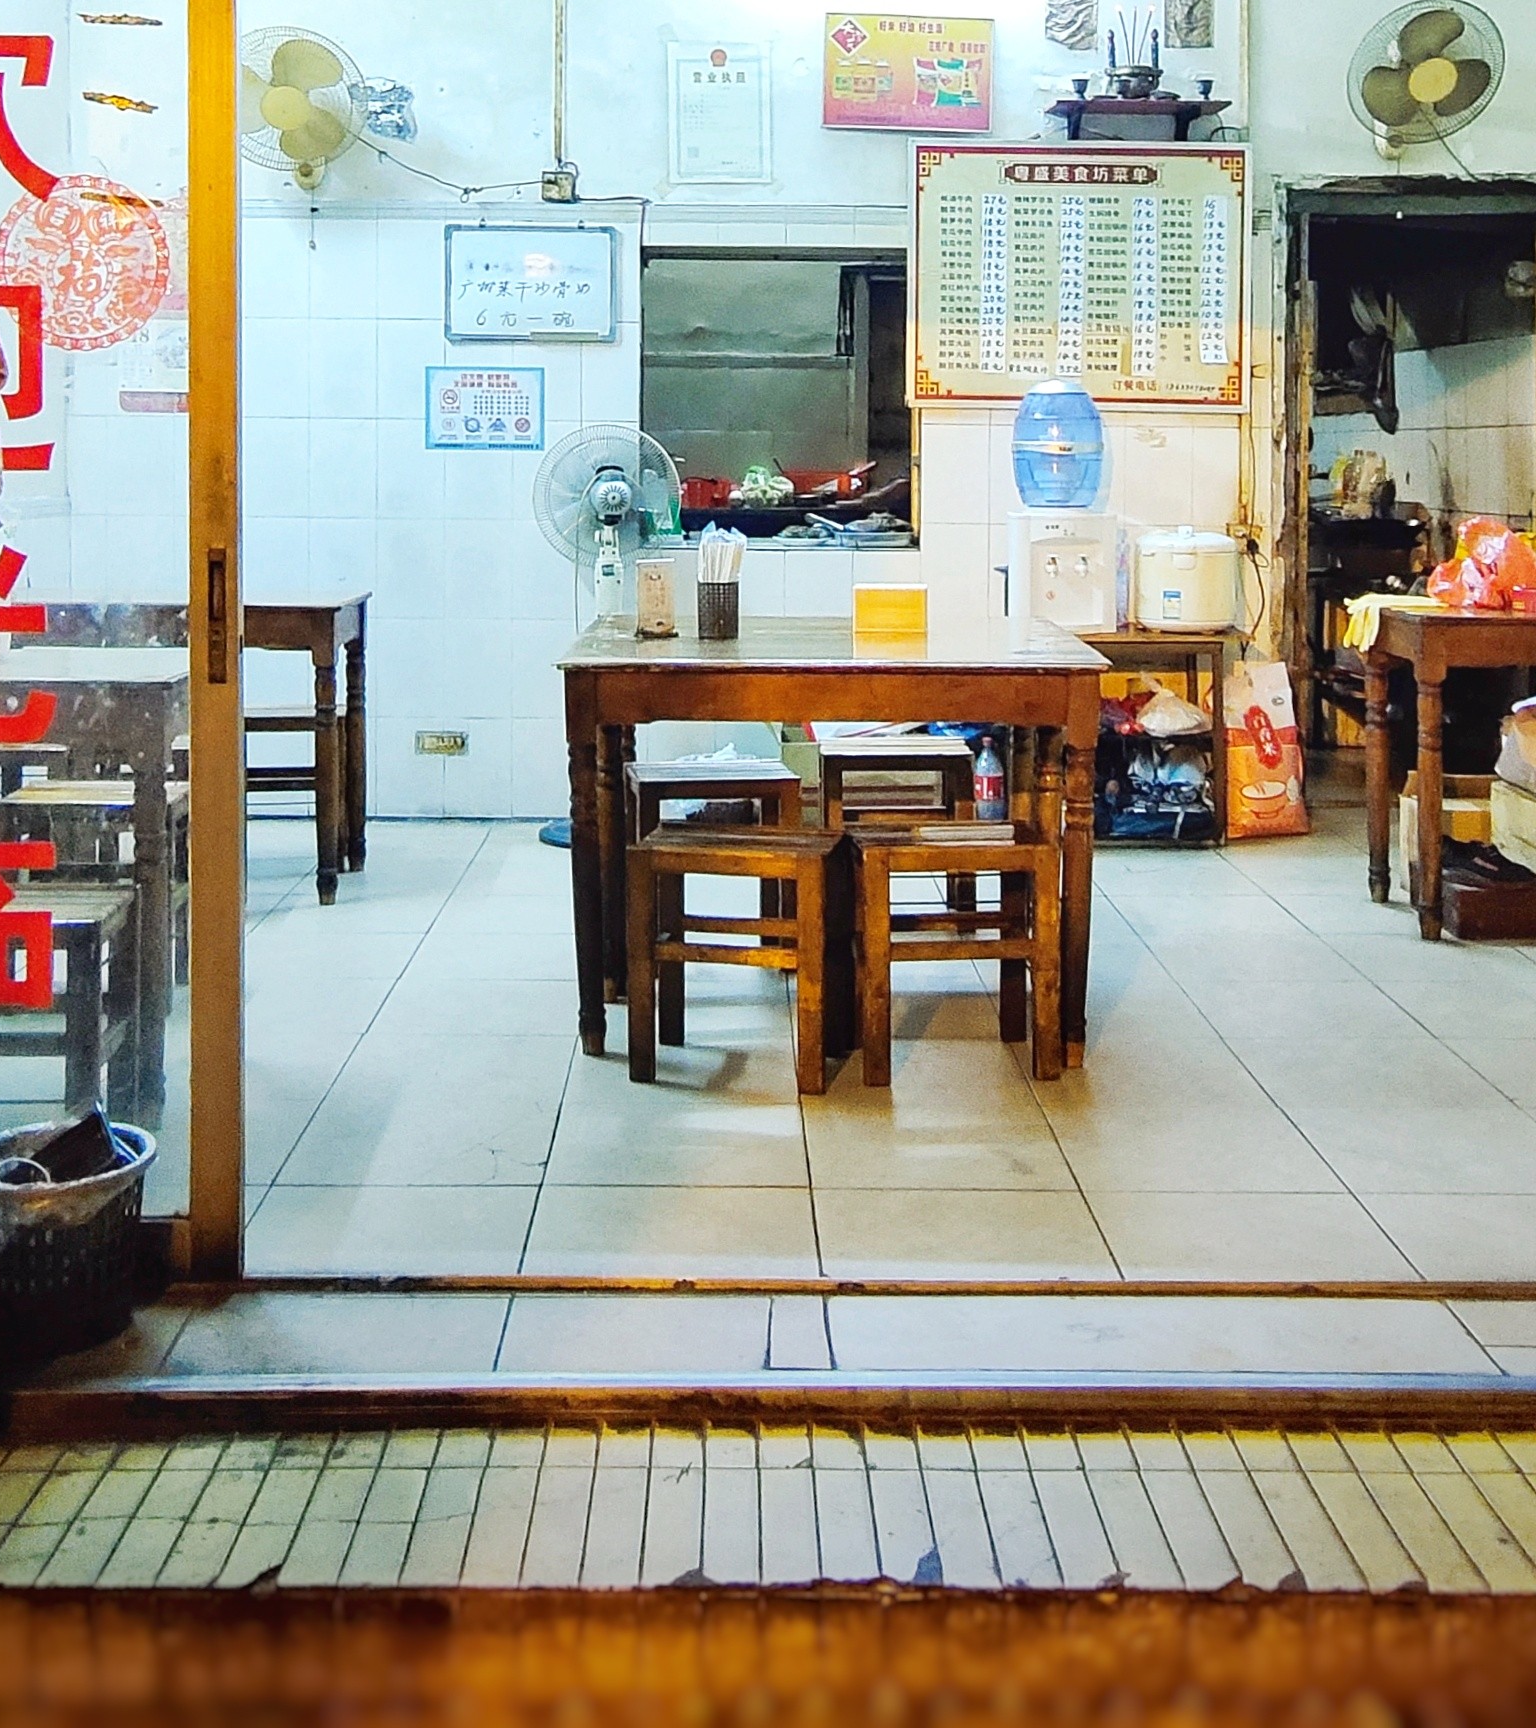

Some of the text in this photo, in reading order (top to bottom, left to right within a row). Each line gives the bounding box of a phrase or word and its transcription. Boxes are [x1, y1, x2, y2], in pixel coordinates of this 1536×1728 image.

[693, 71, 746, 83] 营业执照
[1014, 165, 1148, 183] 粤盛美食坊菜单
